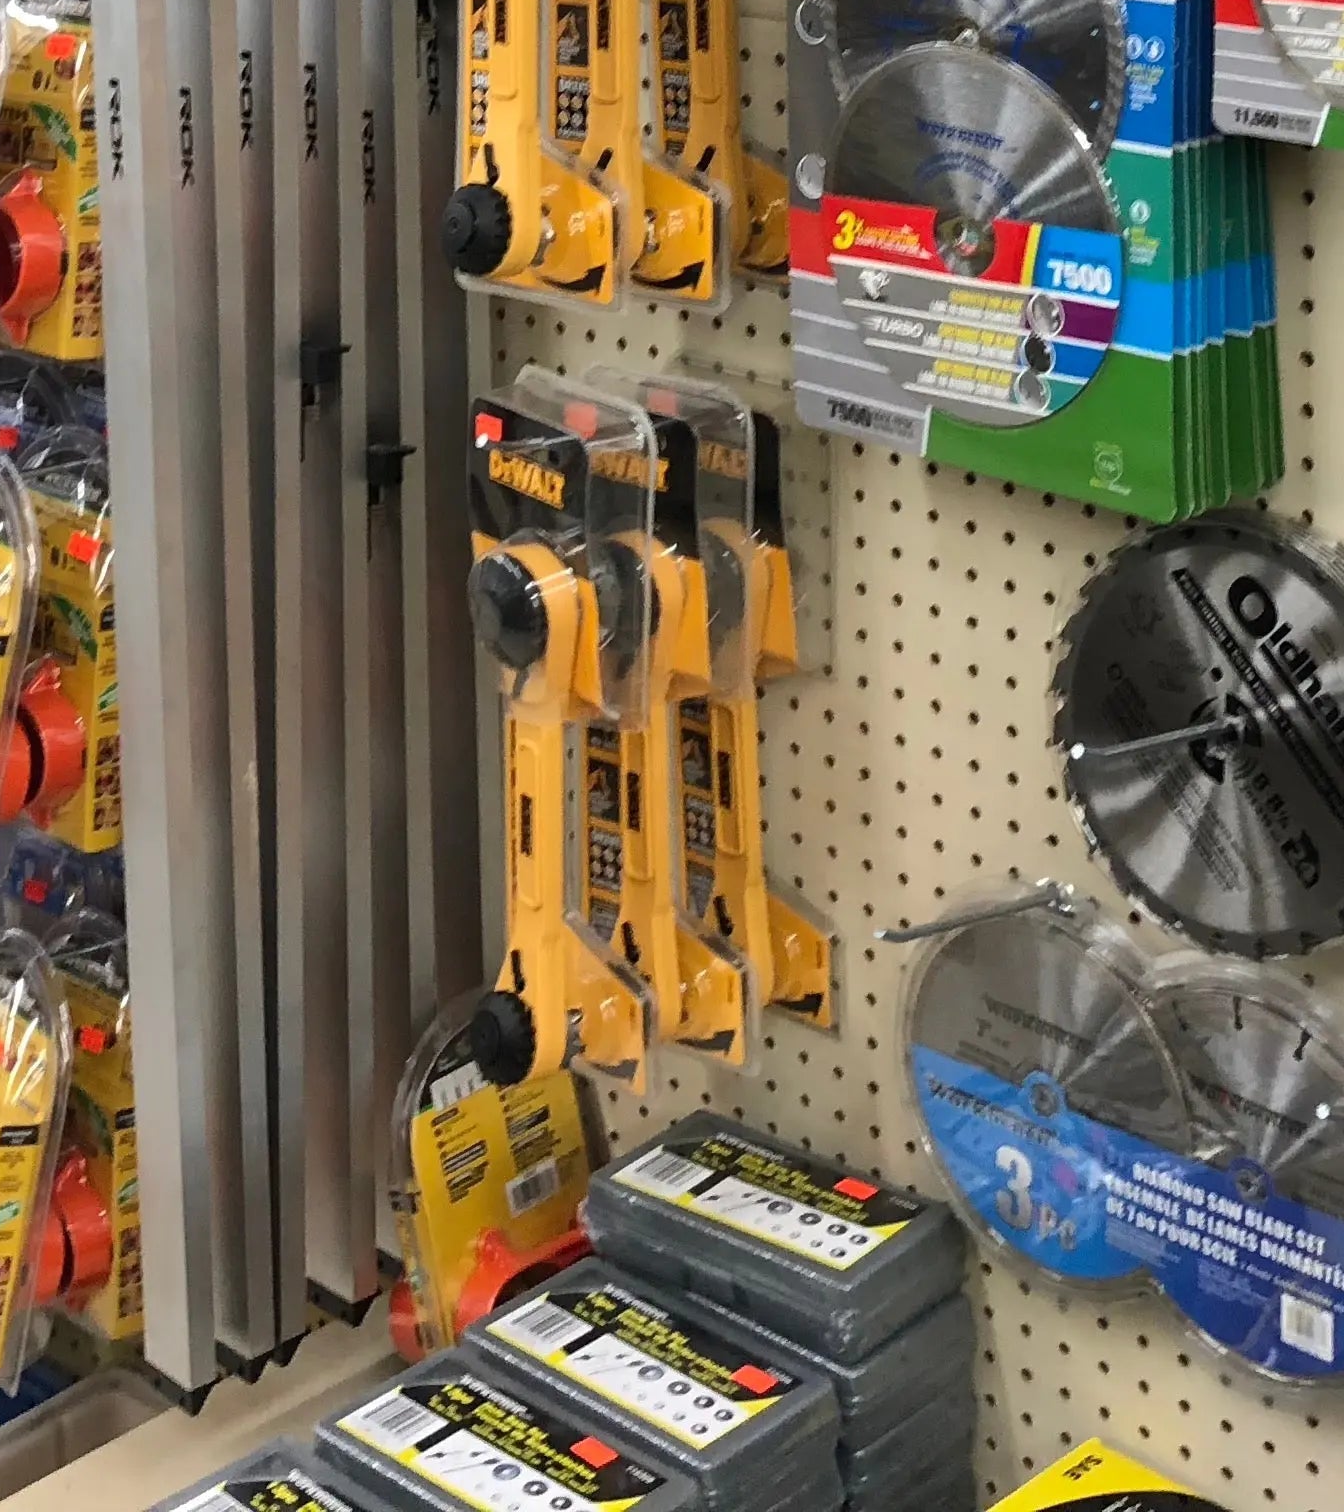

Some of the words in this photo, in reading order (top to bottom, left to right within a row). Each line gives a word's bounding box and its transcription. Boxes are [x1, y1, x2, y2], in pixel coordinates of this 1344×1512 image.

[109, 77, 125, 182] ROK
[303, 62, 320, 162] ROK
[1046, 258, 1113, 294] 7500
[995, 1144, 1033, 1230] 3
[1132, 1162, 1206, 1207] DIAMOND
[1206, 1191, 1244, 1222] SAW
[1244, 1208, 1294, 1244] BLADE
[1294, 1228, 1327, 1256] SET
[1185, 1207, 1206, 1230] DE
[1206, 1215, 1259, 1253] LAMES
[1201, 1236, 1238, 1267] SCIE
